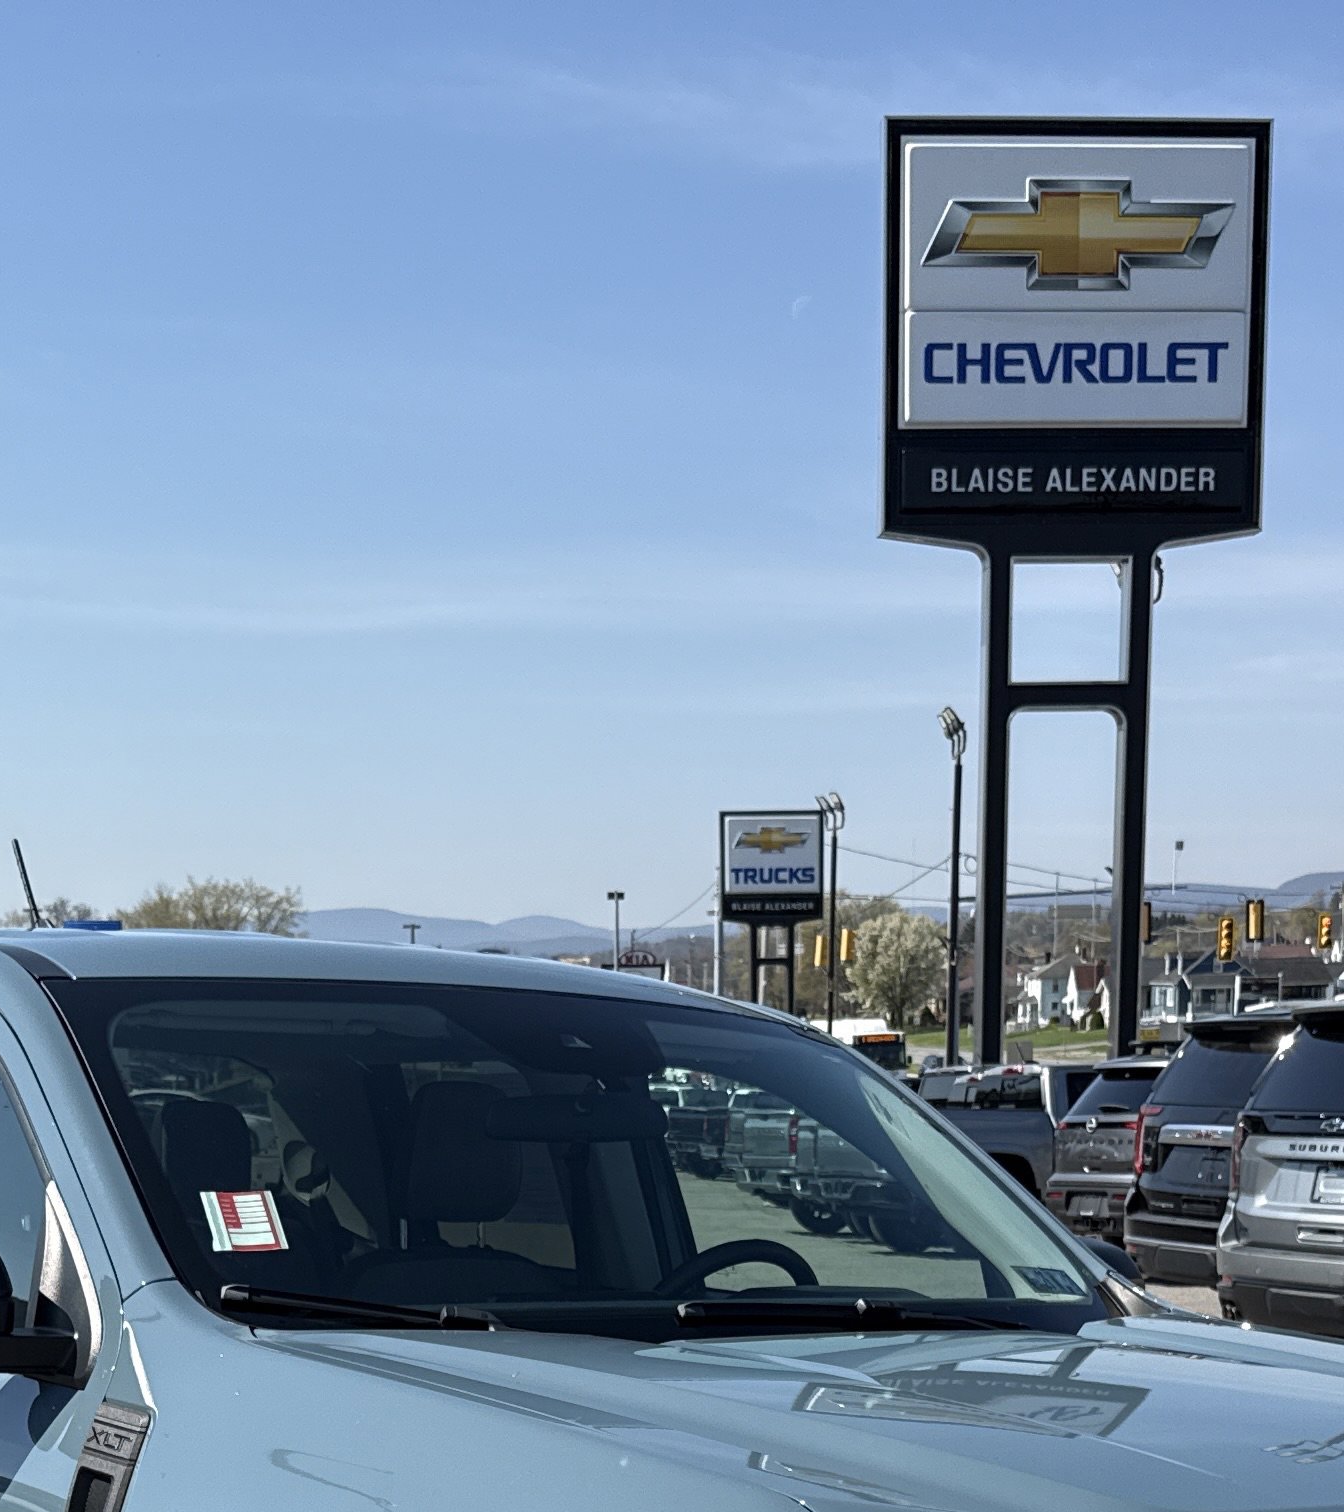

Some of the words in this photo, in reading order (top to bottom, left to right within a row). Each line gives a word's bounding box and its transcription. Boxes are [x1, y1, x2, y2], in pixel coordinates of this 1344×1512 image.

[923, 341, 1229, 384] CHEVROLET
[930, 467, 1033, 493] BLAISE
[1045, 467, 1216, 493] ALEXANDER
[730, 867, 816, 885] TRUCKS
[731, 902, 762, 911] BLAISE
[765, 902, 814, 911] ALEXANDER
[86, 1425, 133, 1451] XLT
